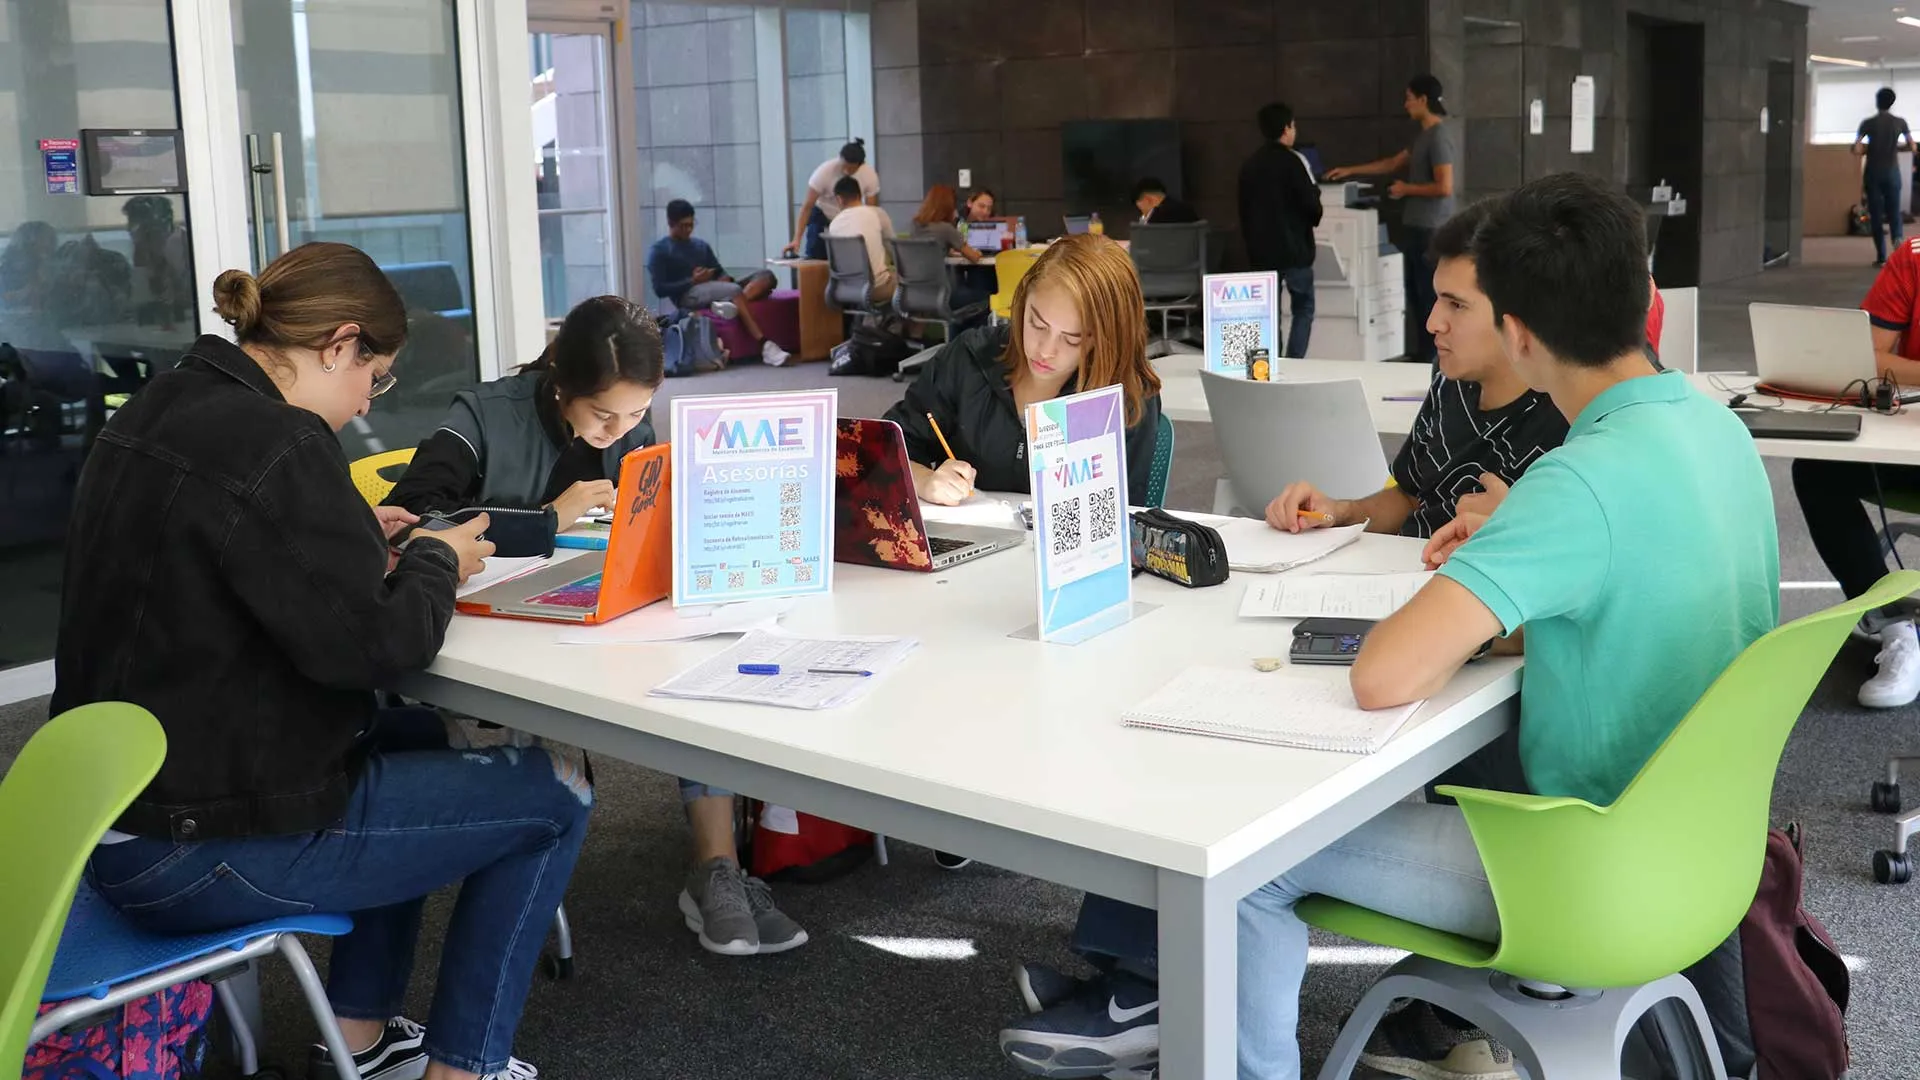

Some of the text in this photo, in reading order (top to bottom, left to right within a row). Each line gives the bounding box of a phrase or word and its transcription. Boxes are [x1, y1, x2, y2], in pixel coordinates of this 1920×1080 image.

[1222, 285, 1262, 300] MAE
[713, 418, 804, 450] MAE
[1016, 442, 1025, 460] NIKE
[702, 461, 808, 484] Asesorías
[1063, 453, 1104, 488] MAE
